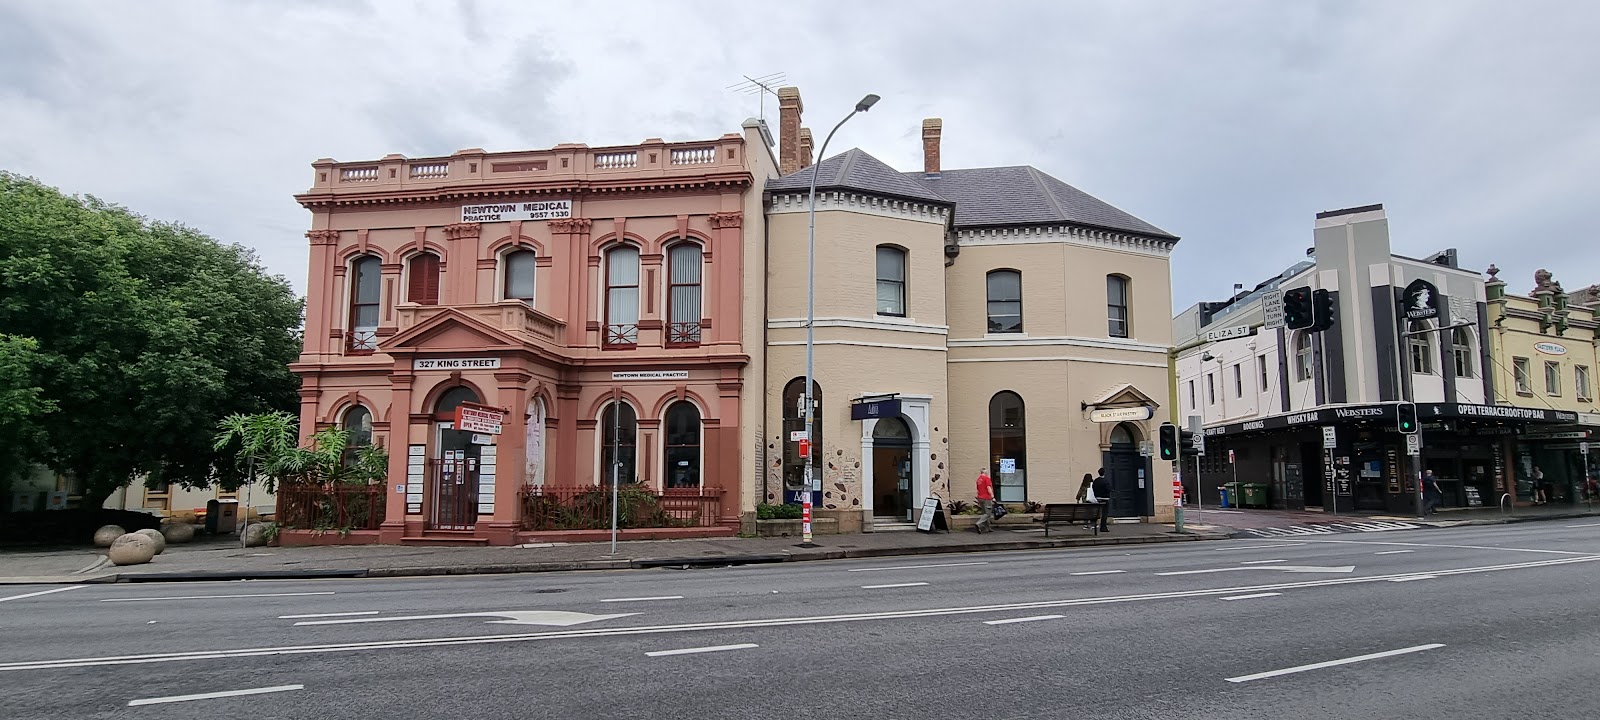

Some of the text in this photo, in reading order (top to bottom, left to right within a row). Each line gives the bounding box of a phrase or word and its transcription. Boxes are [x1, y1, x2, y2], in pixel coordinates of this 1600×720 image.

[463, 201, 570, 215] NEWTOWN MEDICAL
[463, 214, 501, 222] PRACTICE
[1263, 292, 1280, 301] RIGHT
[1264, 299, 1281, 308] LANE
[1266, 312, 1282, 320] TURN
[1266, 319, 1283, 327] RIGHT
[1208, 326, 1247, 340] ELIZA ST
[419, 359, 496, 368] 327 KING STREET
[1458, 404, 1477, 415] OPEN
[1532, 410, 1545, 419] BAR
[1286, 411, 1319, 425] WHISKY BAR
[1242, 420, 1265, 431] BOOKINGS
